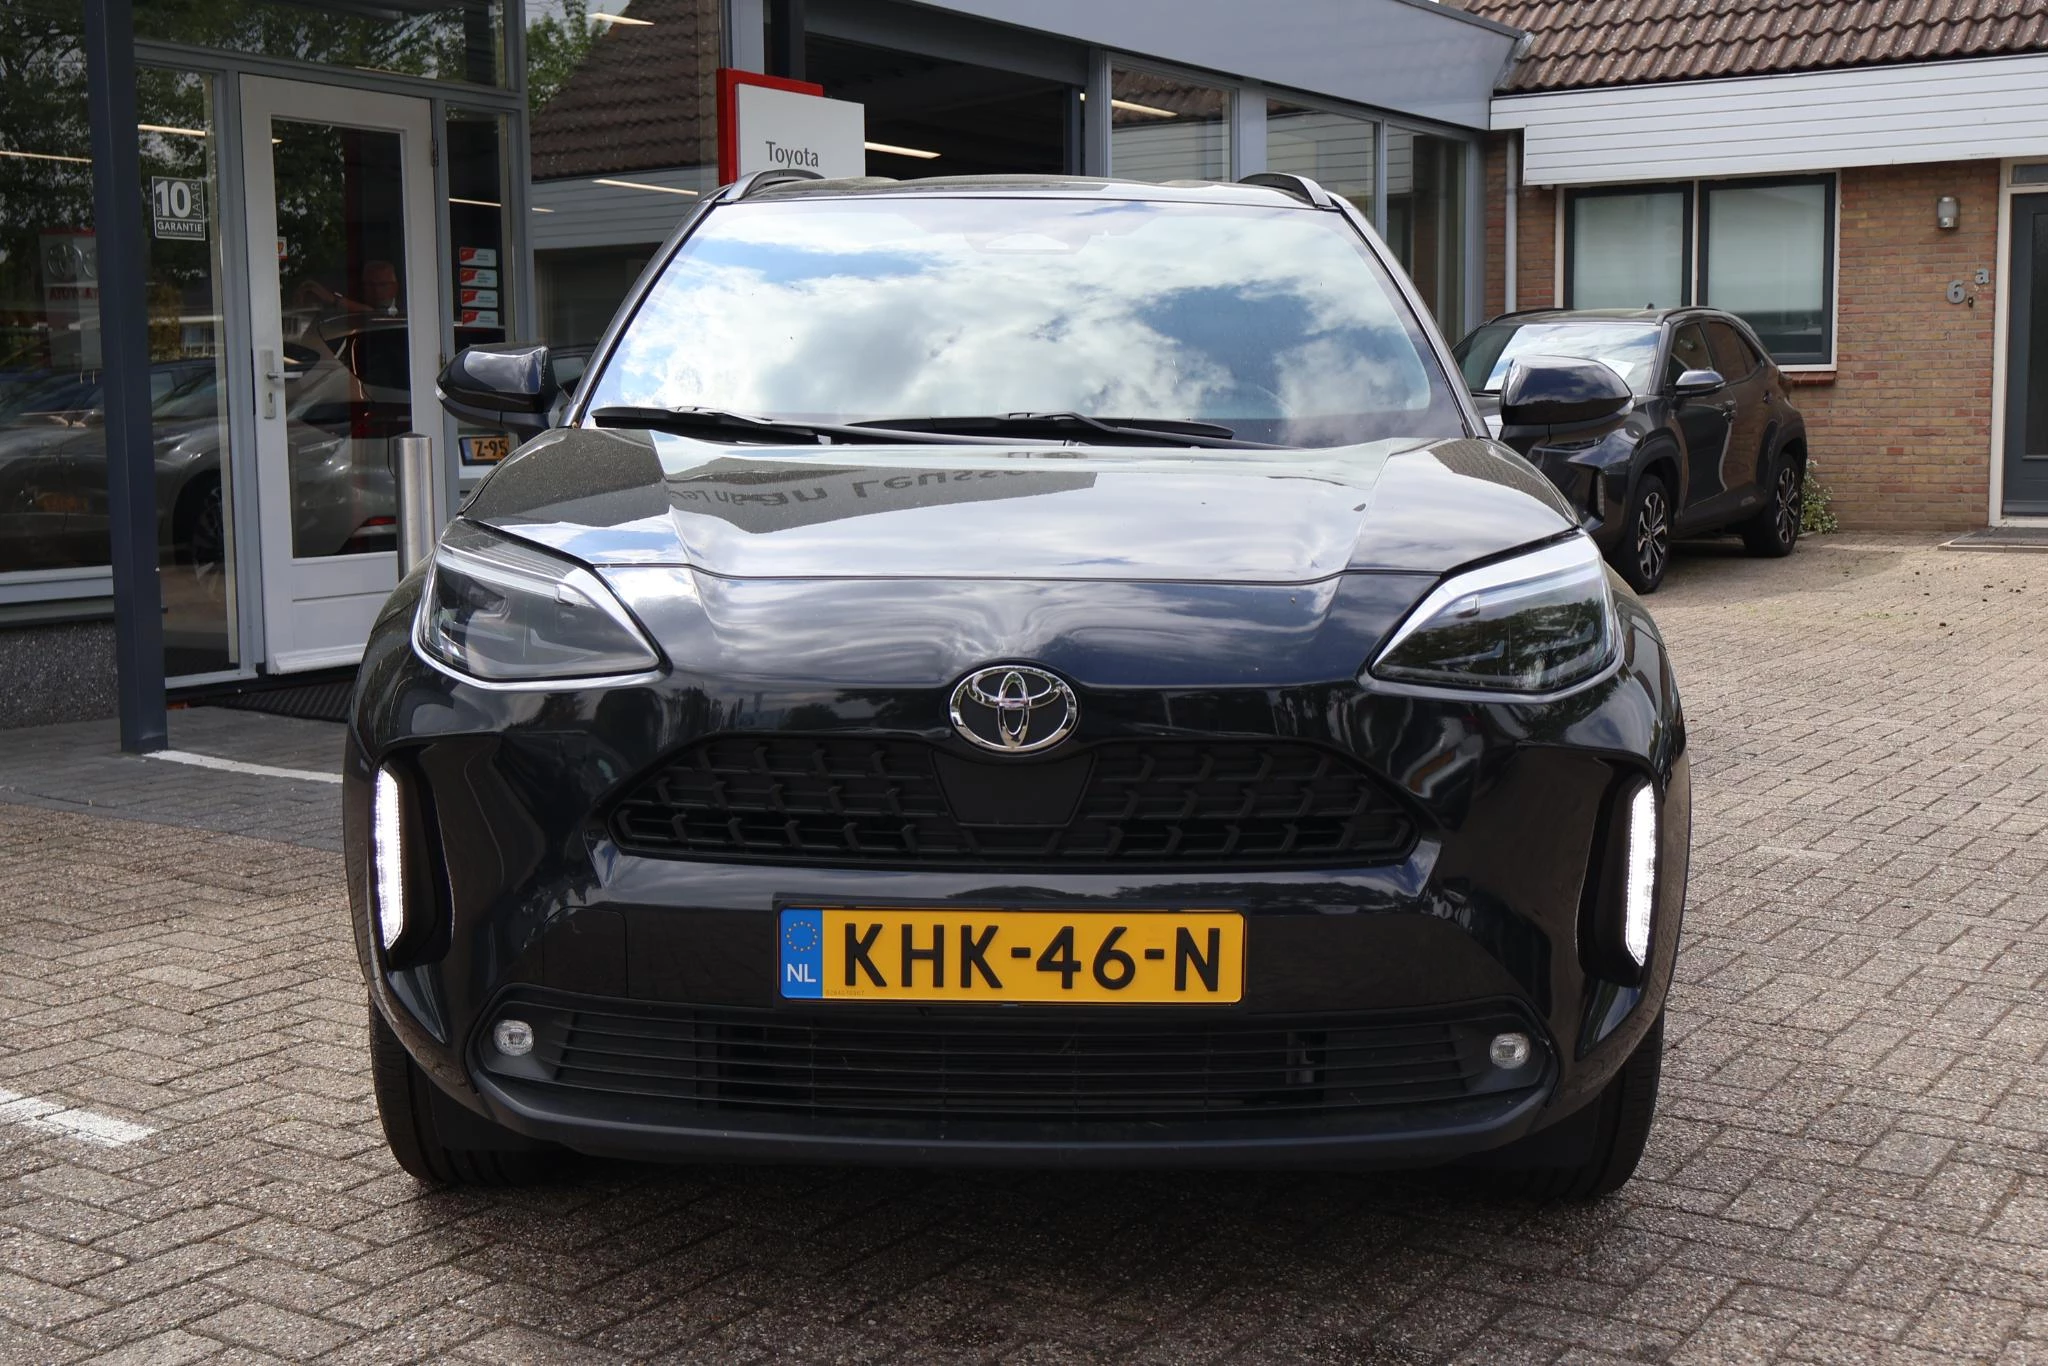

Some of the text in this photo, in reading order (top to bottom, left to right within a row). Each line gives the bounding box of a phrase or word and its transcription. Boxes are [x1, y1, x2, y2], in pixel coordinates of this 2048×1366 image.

[765, 140, 819, 168] Toyota
[155, 181, 191, 217] 10
[191, 183, 201, 218] JAAR
[157, 221, 202, 233] GARANTIE
[1946, 280, 1965, 304] 6
[844, 922, 1221, 992] KHK-46-N
[787, 963, 816, 982] NL
